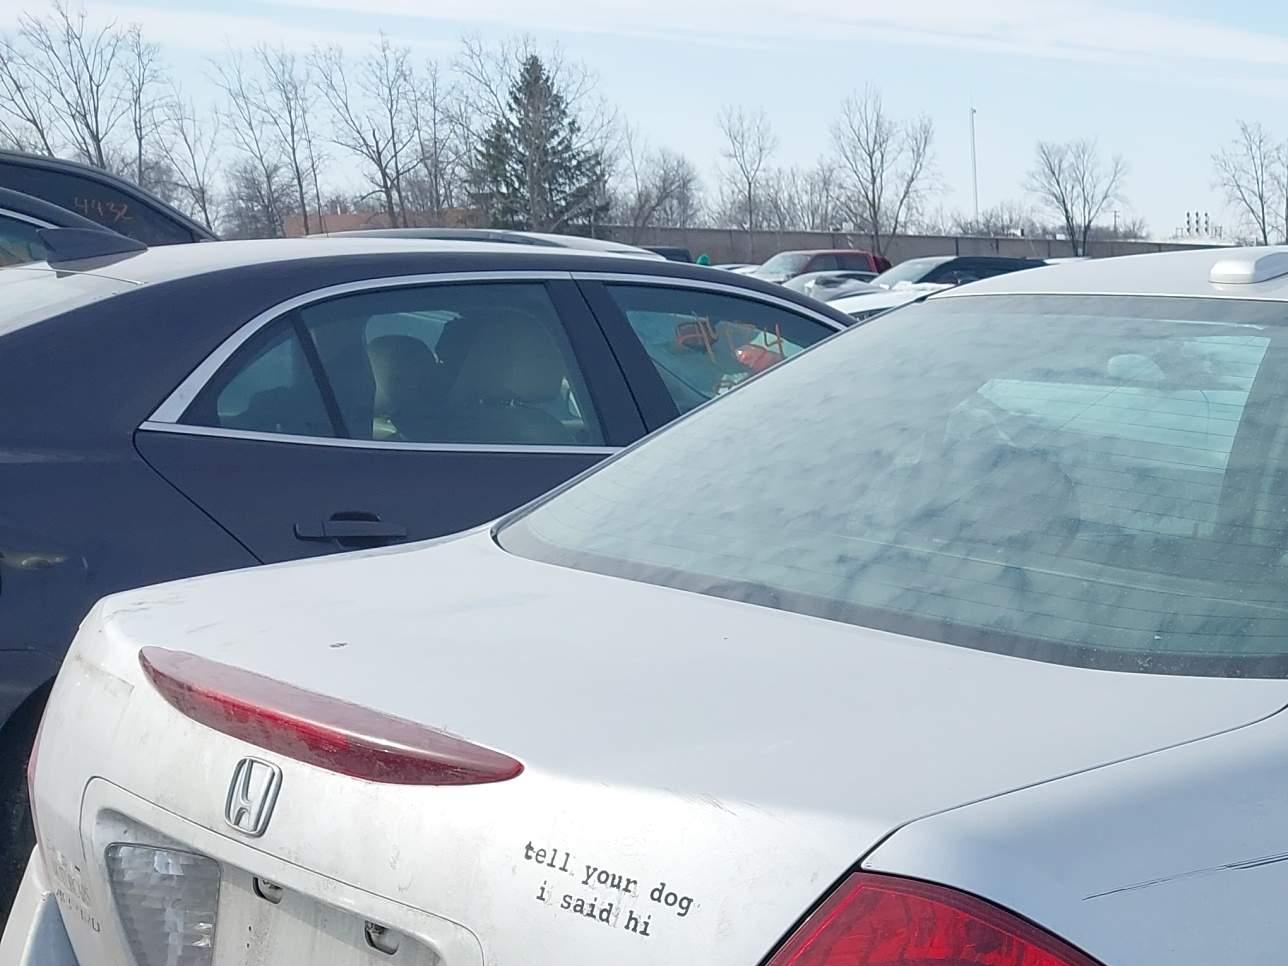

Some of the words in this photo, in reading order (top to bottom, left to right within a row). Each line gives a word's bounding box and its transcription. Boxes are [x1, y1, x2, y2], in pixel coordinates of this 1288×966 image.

[523, 840, 571, 873] tell
[581, 864, 638, 894] your
[649, 882, 694, 918] dog
[535, 880, 548, 902] i
[559, 893, 614, 924] said
[623, 910, 652, 937] hi
